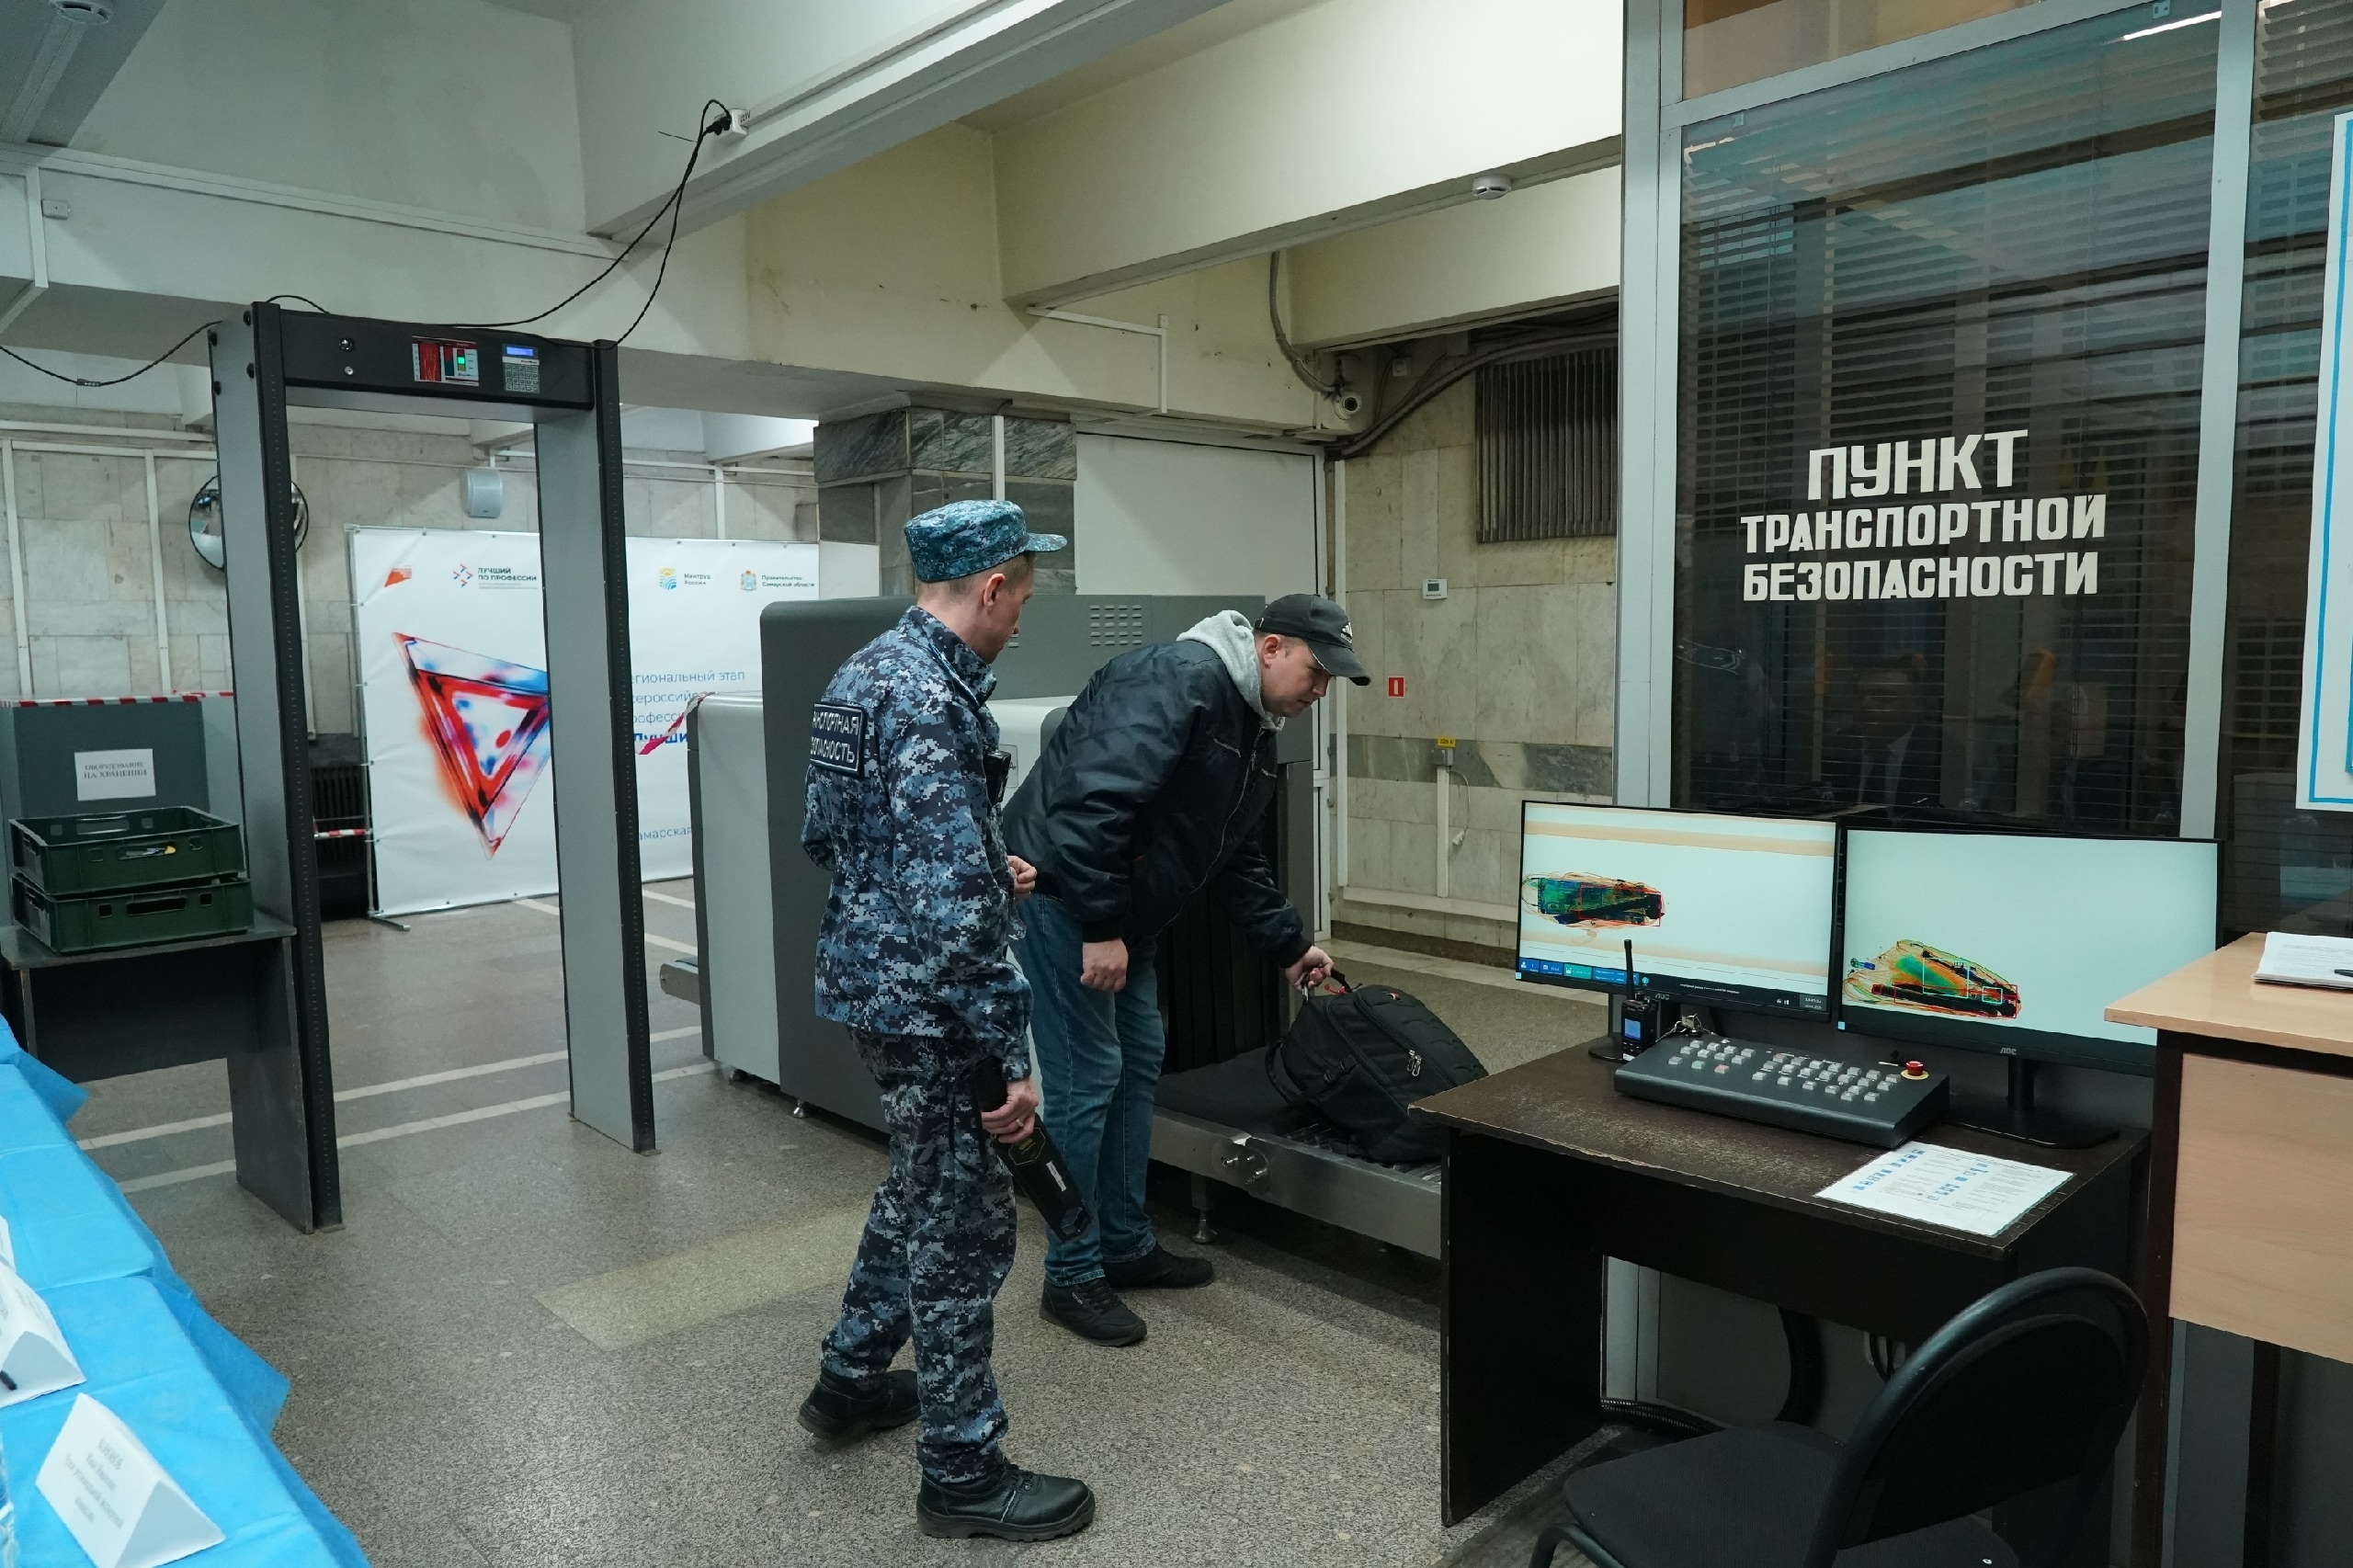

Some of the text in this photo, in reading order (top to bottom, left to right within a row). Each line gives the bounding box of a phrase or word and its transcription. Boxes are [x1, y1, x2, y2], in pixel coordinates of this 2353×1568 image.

[1807, 429, 2029, 500] ПУНКТ
[1741, 494, 2107, 553] ТРАНСПОРТНОЙ
[1743, 551, 2098, 602] БЕЗОПАСНОСТИ
[718, 671, 745, 681] этап
[1999, 1047, 2018, 1056] AOC
